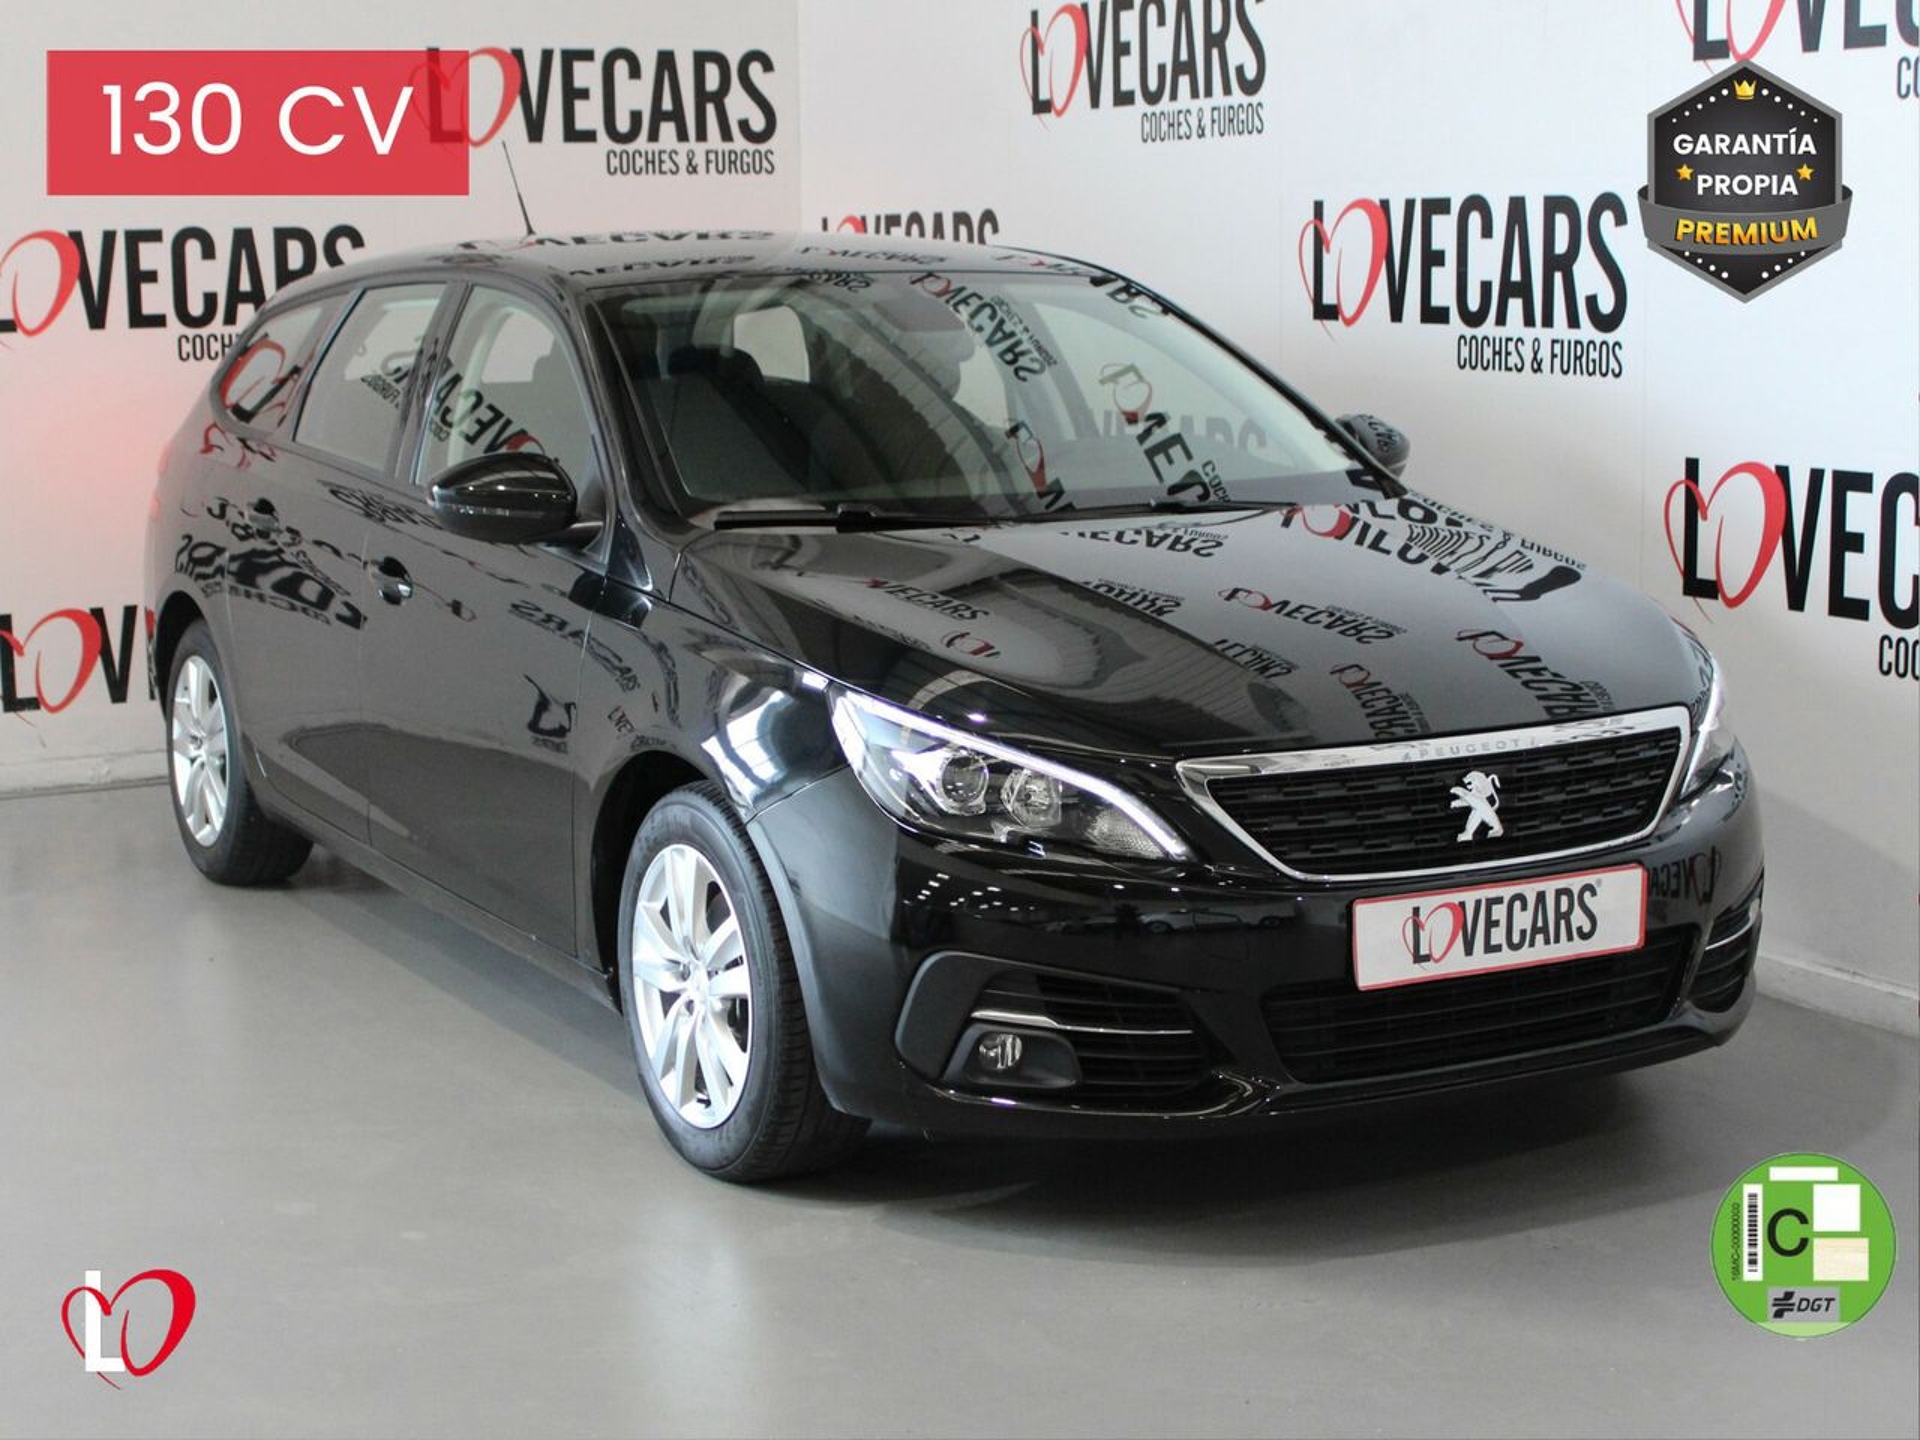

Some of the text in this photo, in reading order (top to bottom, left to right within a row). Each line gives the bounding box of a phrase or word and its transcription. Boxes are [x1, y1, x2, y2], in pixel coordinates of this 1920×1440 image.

[1020, 0, 1267, 130] LOVECARS
[411, 47, 777, 155] LOVECARS
[1141, 102, 1264, 143] COCHES & FURGOS
[606, 148, 775, 175] COCHES & FURGOS
[0, 225, 366, 346] OVECA
[1299, 191, 1628, 341] LOVECARS
[177, 334, 242, 361] COCH
[1457, 335, 1623, 378] COCHES & FURGOS
[1418, 738, 1520, 759] PEUGEOT
